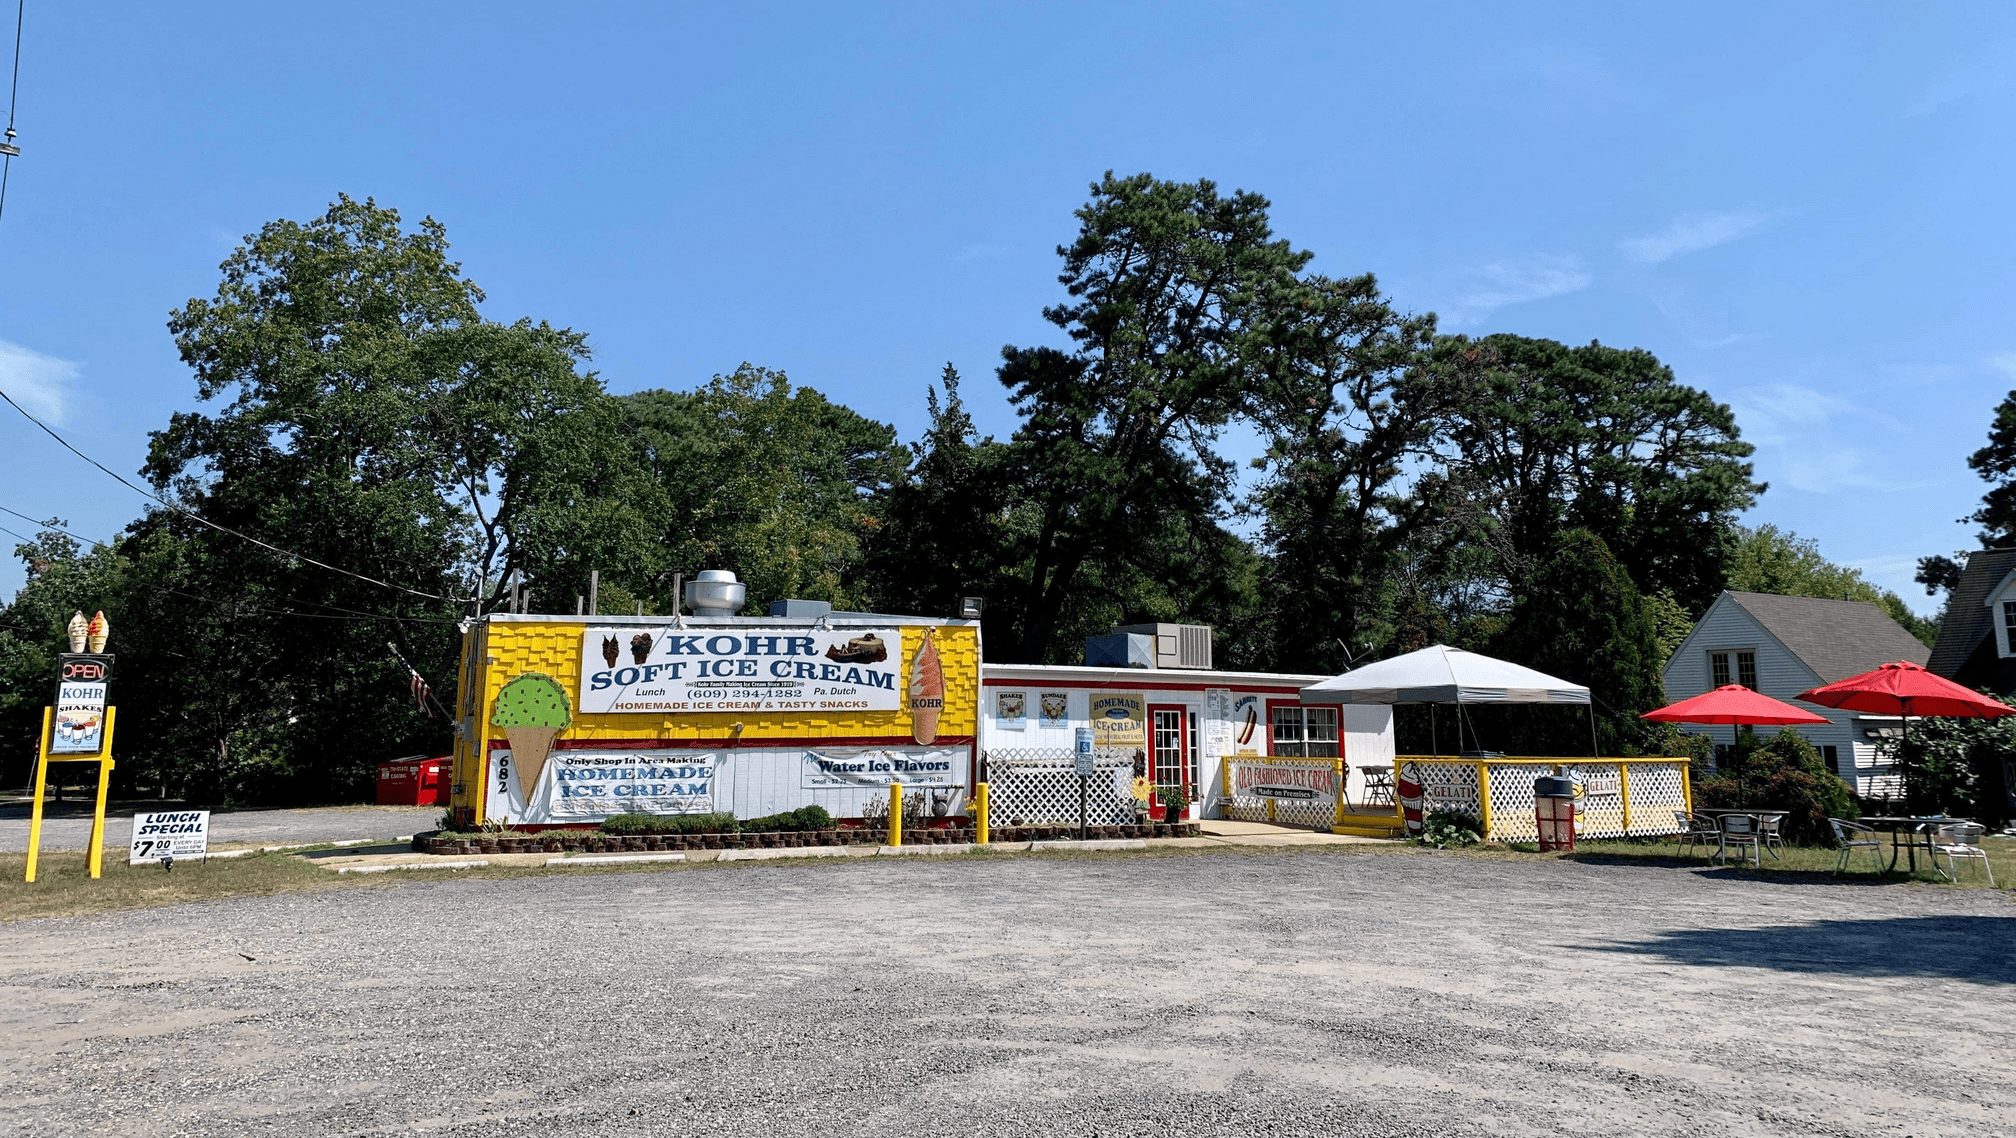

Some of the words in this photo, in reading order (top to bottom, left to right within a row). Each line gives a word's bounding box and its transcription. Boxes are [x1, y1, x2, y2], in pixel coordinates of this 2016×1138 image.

[666, 635, 819, 656] KOHR
[62, 664, 105, 678] OPEN
[591, 661, 687, 691] SOFT
[697, 659, 758, 678] ICE
[770, 659, 895, 691] CREAM
[61, 688, 103, 698] KOHR
[635, 688, 666, 696] Lunch
[687, 689, 728, 700] (609)
[732, 689, 803, 698] 294-1282
[813, 687, 828, 696] Pa.
[830, 687, 857, 695] Dutch
[615, 702, 689, 710] HOMEMADE
[765, 701, 776, 709] &
[778, 701, 817, 709] TASTY
[820, 701, 869, 709] SNACKS
[911, 699, 942, 708] KOHR
[1093, 697, 1140, 711] HOMEMADE
[1093, 719, 1108, 731] ICE
[1111, 719, 1143, 732] CREAM
[566, 758, 592, 766] Only
[594, 758, 623, 766] Shop
[818, 760, 865, 772] Water
[869, 760, 890, 771] Ice
[894, 760, 949, 771] Flavors
[557, 766, 713, 781] HOMEMADE
[1239, 766, 1253, 789] OLD
[1254, 767, 1292, 786] FASHIONED
[1293, 770, 1306, 787] ICE
[1308, 770, 1334, 797] CREAM
[1590, 779, 1617, 792] GELATI
[562, 785, 606, 798] ICE
[613, 783, 708, 797] CREAM
[1283, 790, 1311, 798] Premises
[1433, 786, 1472, 798] GELATI
[146, 813, 201, 823] LUNCH
[138, 823, 203, 834] SPECIAL
